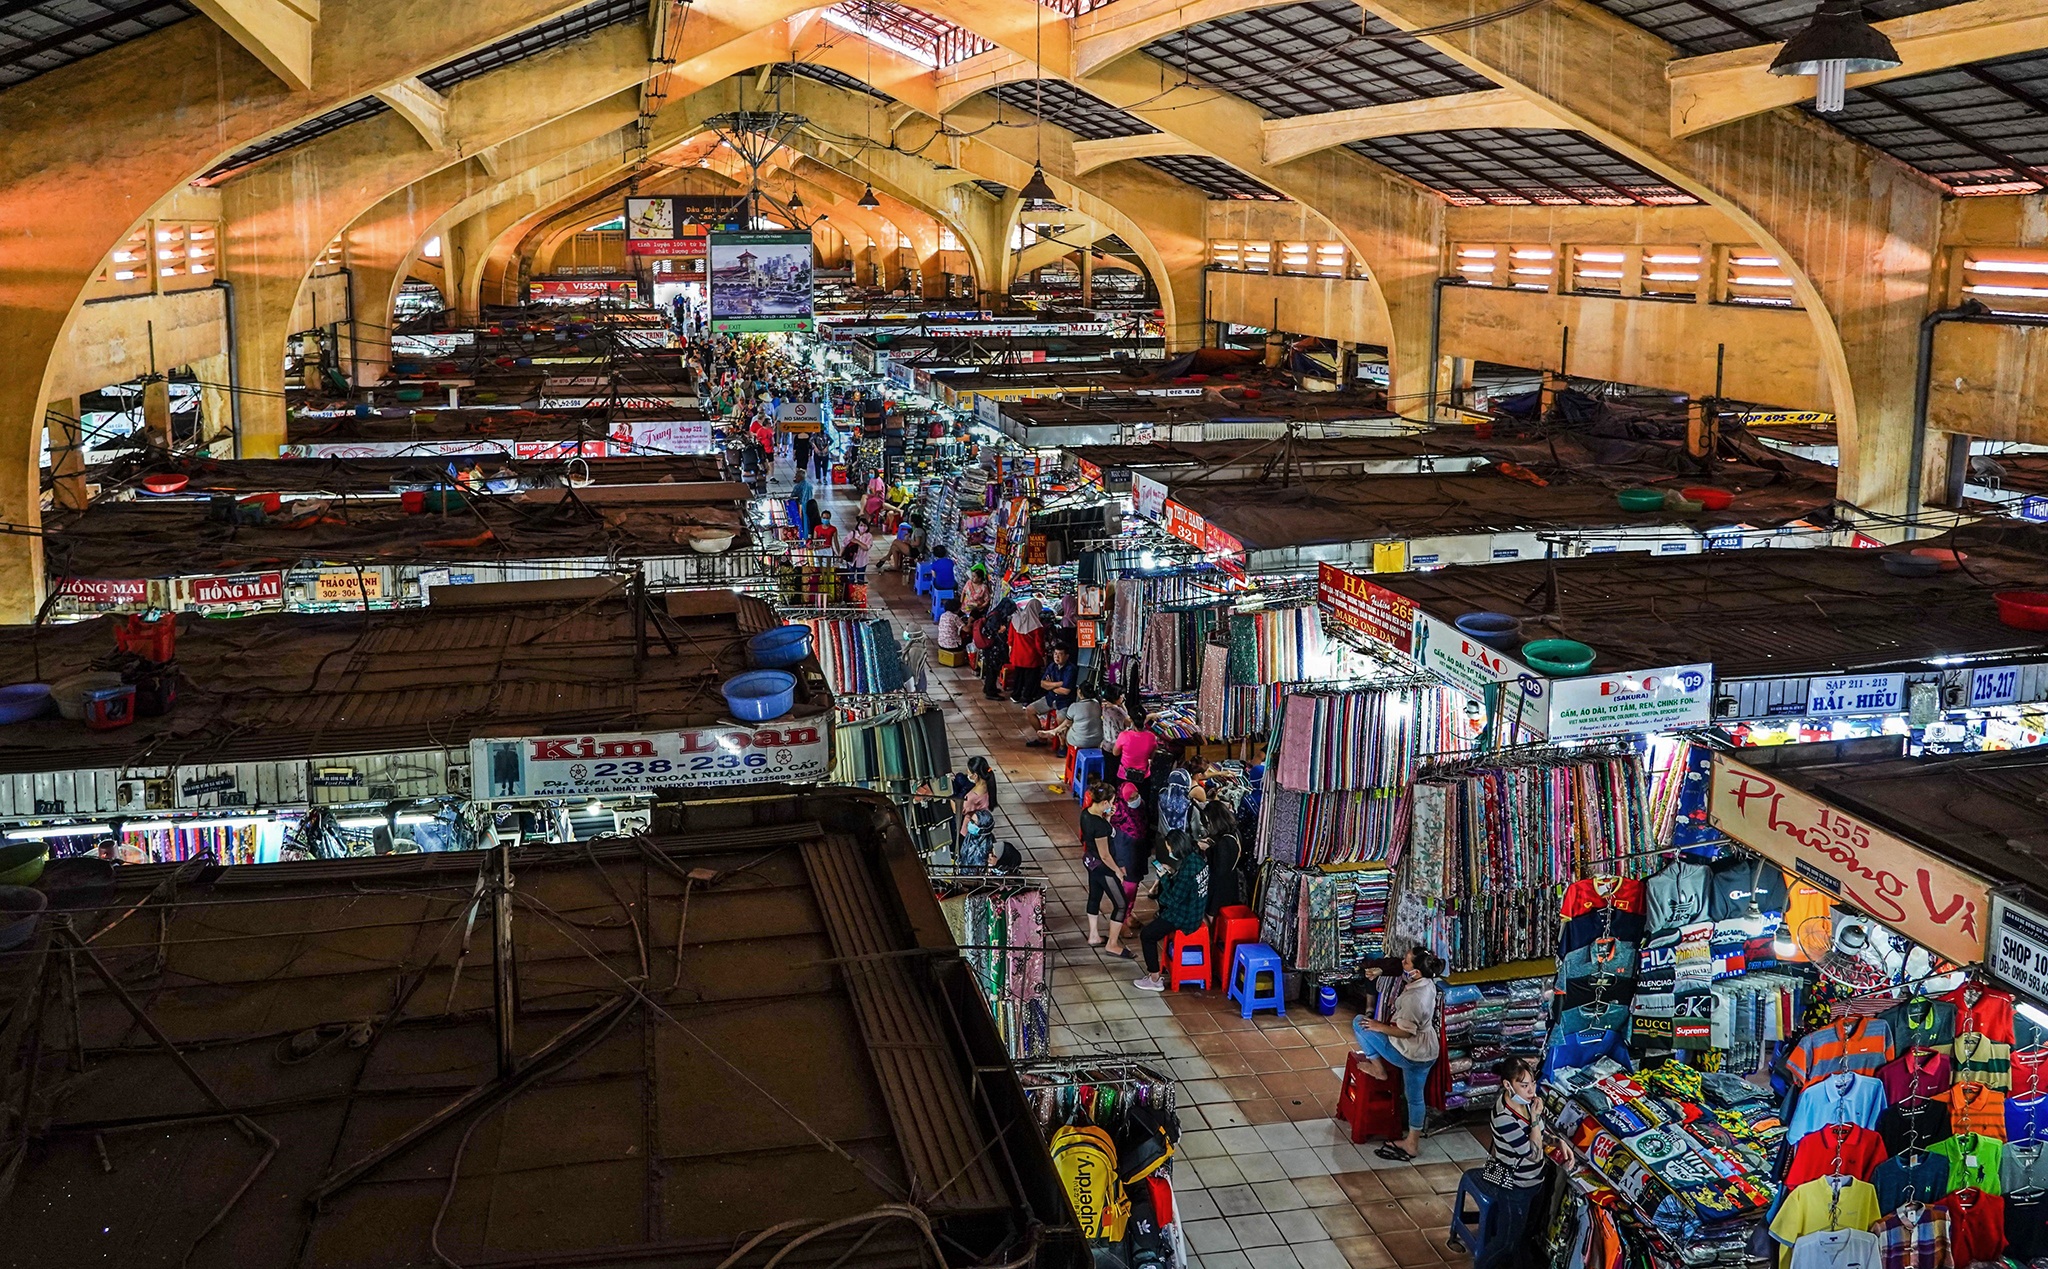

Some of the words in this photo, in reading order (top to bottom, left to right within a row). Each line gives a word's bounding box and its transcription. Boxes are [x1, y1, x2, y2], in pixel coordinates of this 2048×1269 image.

[573, 282, 608, 290] VISSAN
[1070, 324, 1090, 332] MAI
[1091, 324, 1104, 332] LY
[1764, 413, 1786, 423] 495
[1797, 413, 1820, 422] 497
[1137, 433, 1152, 441] 485
[1177, 526, 1199, 546] 321
[112, 582, 144, 594] MAI
[199, 581, 243, 601] HỒNG
[247, 580, 278, 596] MAI
[320, 576, 346, 588] THẢO
[346, 577, 378, 588] QUNH
[1342, 570, 1368, 601] HÀ
[322, 590, 337, 598] 302
[341, 589, 356, 597] 304
[1391, 600, 1412, 622] 265
[1335, 607, 1359, 627] MAKE
[1360, 619, 1377, 637] ONE
[1378, 628, 1397, 647] DAY
[1460, 635, 1508, 678] ĐÀO
[1470, 657, 1498, 680] (SAKURA)
[1825, 680, 1846, 690] SẠP
[1848, 679, 1865, 688] 211
[1872, 677, 1888, 687] 213
[1974, 671, 2016, 700] 215-217
[1613, 692, 1649, 702] (SAKURA)
[1812, 689, 1844, 711] HẢI
[1856, 686, 1898, 710] HIẾU
[1560, 707, 1578, 719] GẤM,
[1580, 707, 1590, 716] ÁO
[1592, 706, 1606, 715] DÀI,
[1639, 700, 1655, 710] REN,
[530, 736, 658, 762] Kim
[679, 726, 822, 754] Loan
[594, 753, 767, 777] 238-236
[610, 775, 640, 785] VẢI
[645, 772, 697, 784] NGOẠI
[701, 769, 747, 779] NHẬP
[751, 766, 783, 776] CAO
[788, 759, 819, 771] CẤP
[534, 788, 554, 796] BÁN
[594, 785, 610, 793] GIÁ
[612, 784, 637, 792] NHẤT
[1816, 808, 1871, 849] 155
[1641, 948, 1677, 968] FILA
[2001, 936, 2032, 967] SHOP
[2035, 952, 2048, 978] 10
[2011, 965, 2028, 985] 0909
[2027, 975, 2041, 993] 593
[1635, 1018, 1671, 1030] GUCCI
[1676, 1027, 1709, 1036] Supreme
[1074, 1155, 1098, 1236] Superdry.
